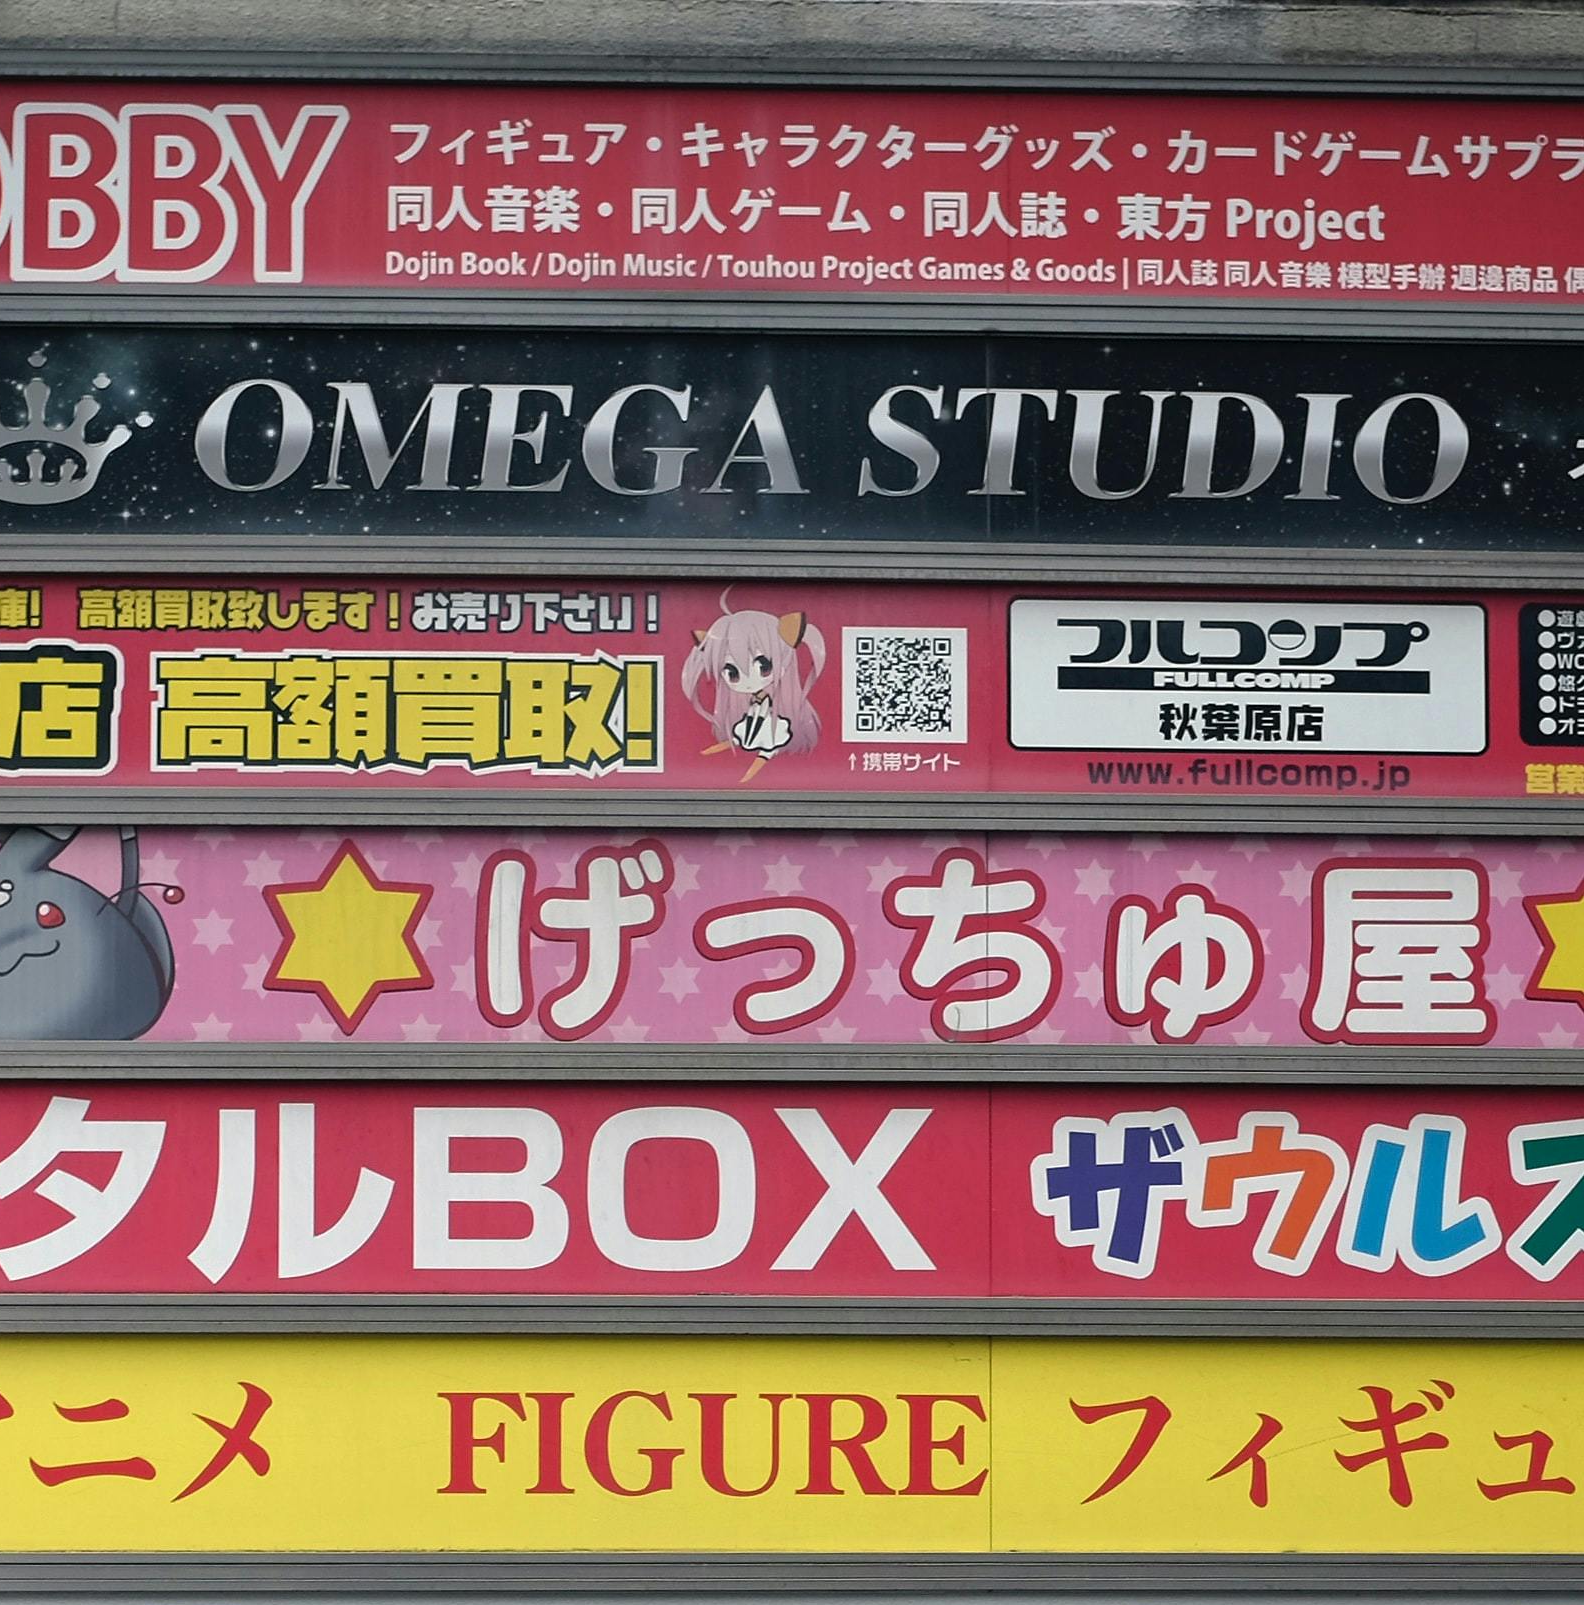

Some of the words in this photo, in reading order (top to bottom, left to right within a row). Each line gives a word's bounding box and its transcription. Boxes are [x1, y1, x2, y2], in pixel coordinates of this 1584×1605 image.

[1226, 199, 1385, 250] Project
[385, 251, 454, 281] Dojin
[461, 252, 526, 278] Book
[548, 252, 616, 282] Dojin
[623, 253, 696, 279] Music
[718, 254, 815, 280] Touhou
[822, 255, 913, 285] Project
[918, 256, 1005, 282] Games
[1011, 257, 1030, 282] &
[1036, 257, 1116, 284] Goods
[1137, 259, 1218, 287] 同人誌
[194, 377, 811, 498] OMEGA
[857, 385, 1468, 504] STUDIO
[1057, 618, 1430, 667] フルコンプ
[1153, 670, 1335, 691] FULLCOMP
[154, 652, 658, 768] 高額買取!
[1158, 702, 1325, 743] 秋葉原店
[862, 752, 961, 774] 携帯サイト
[1087, 758, 1411, 791] www.fullcomp.jp
[480, 850, 1491, 1040] げっちゅ屋
[437, 1390, 989, 1498] FIGURE
